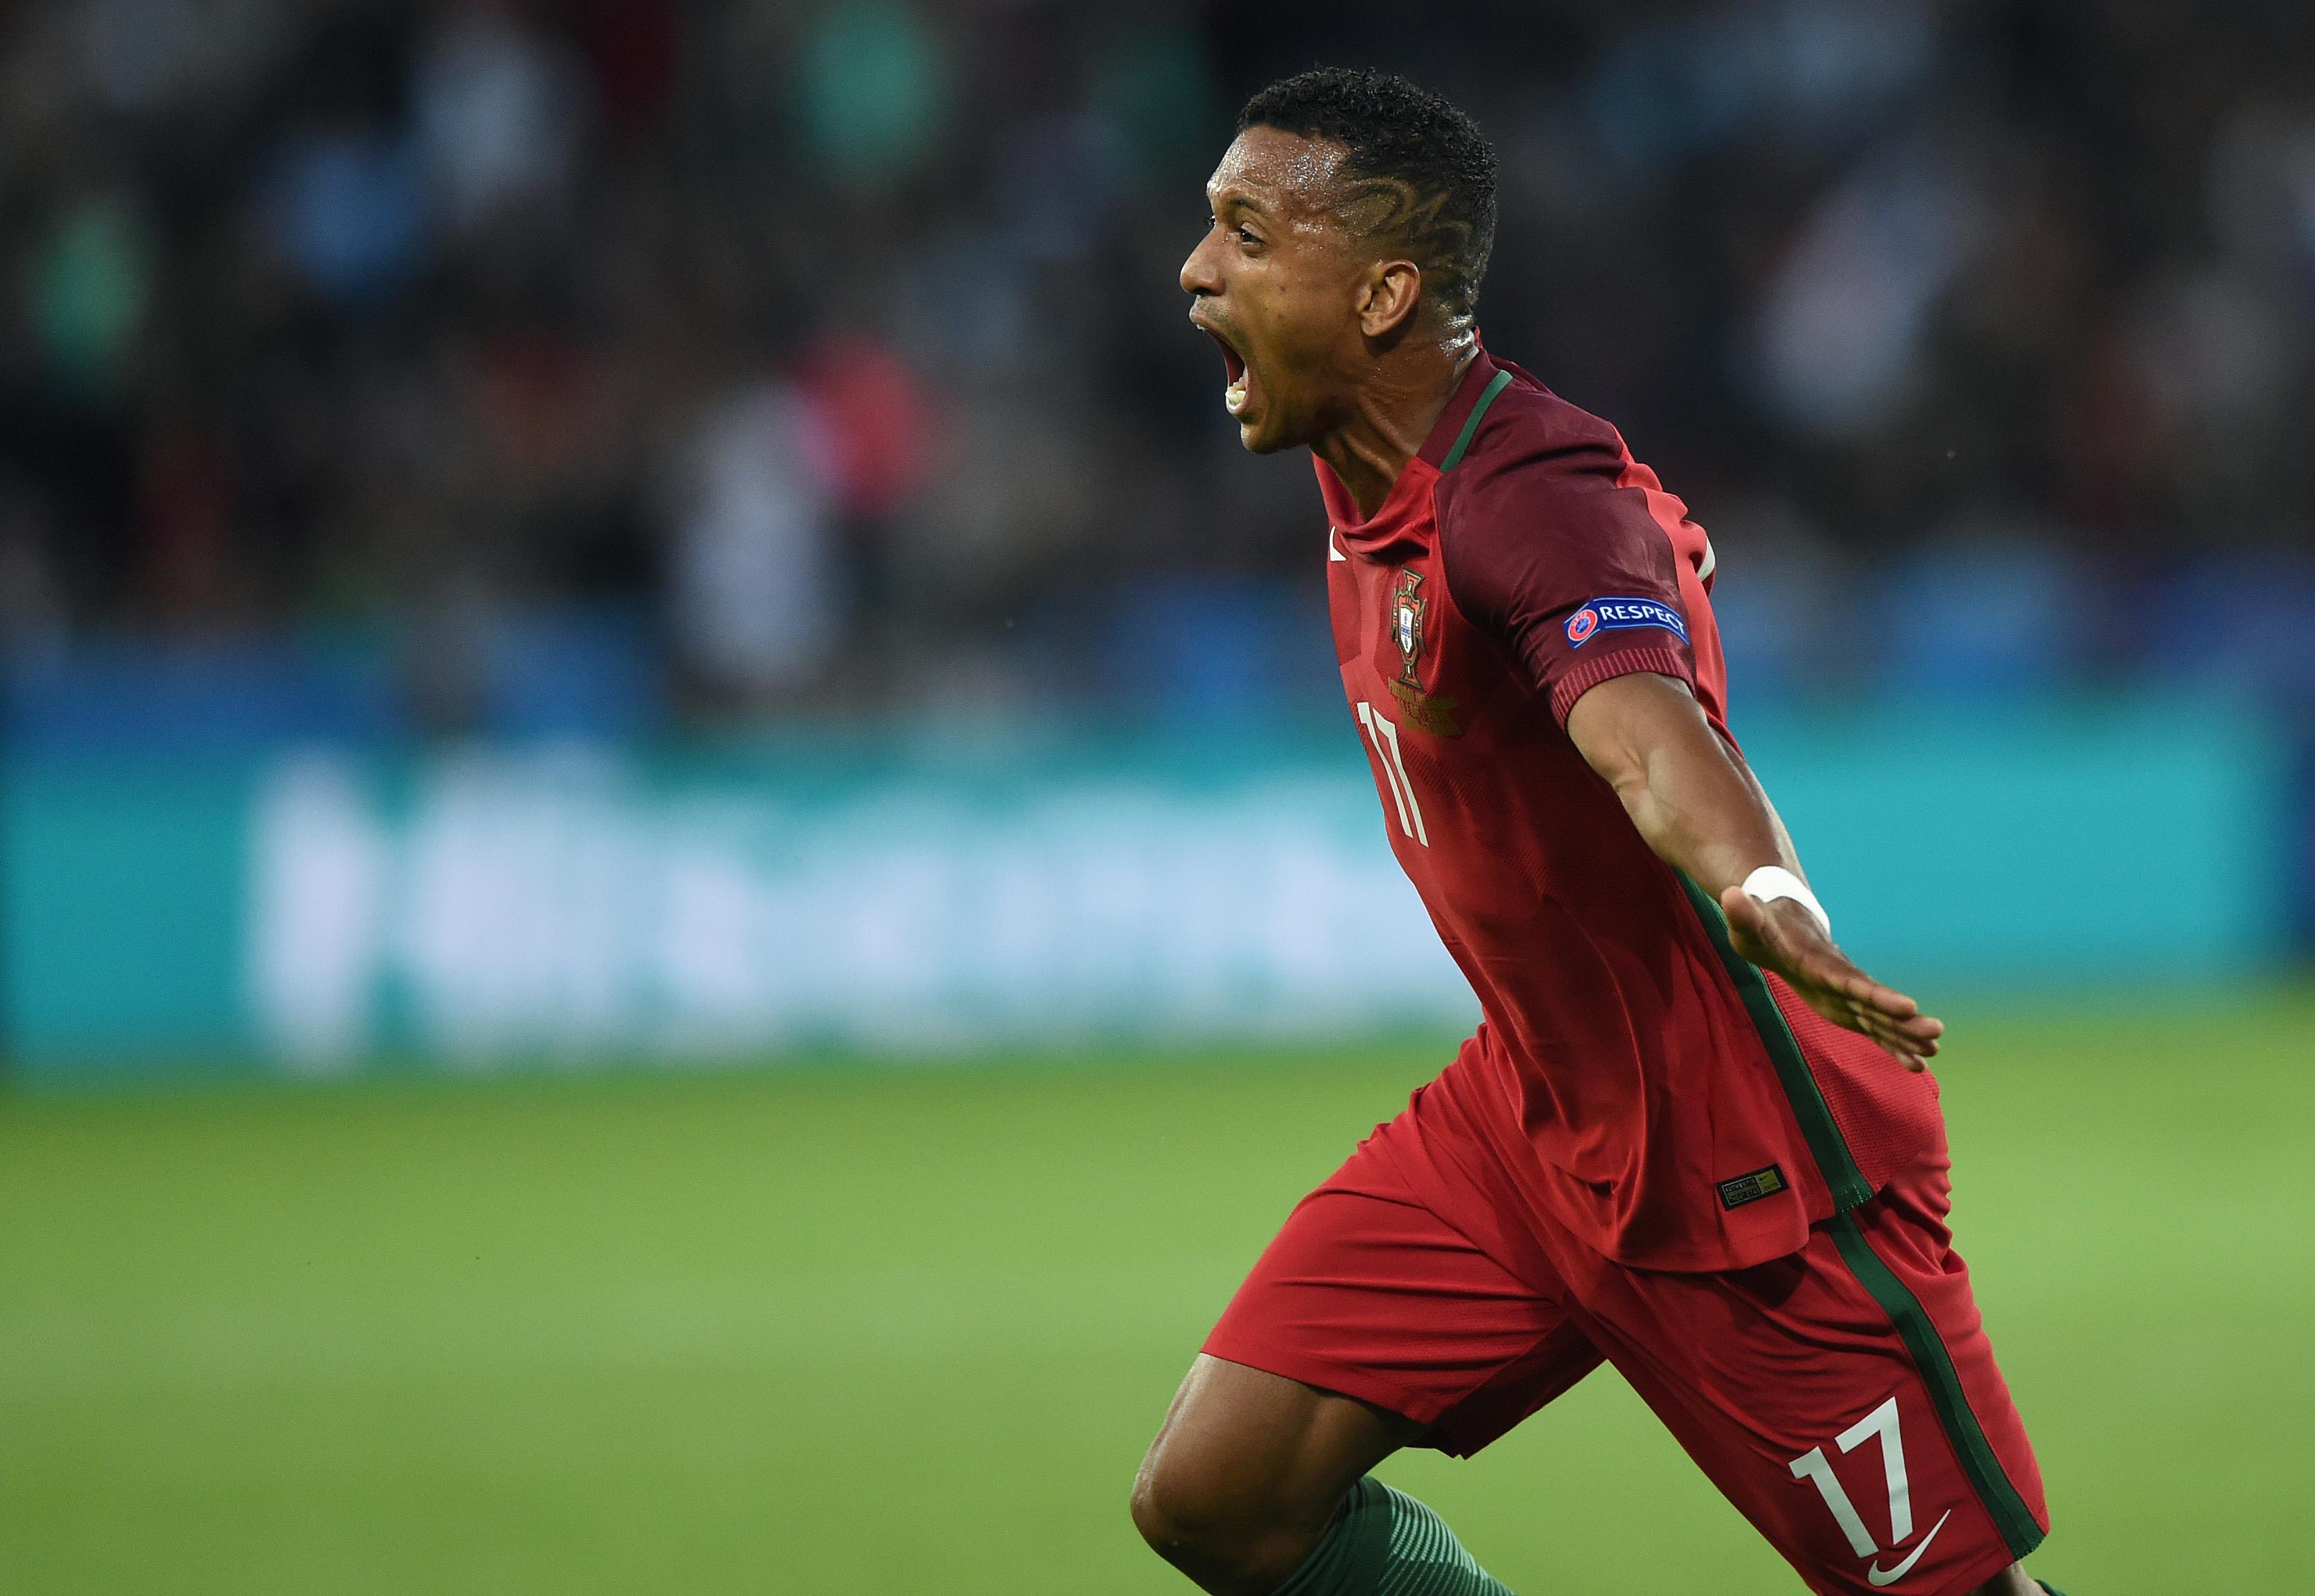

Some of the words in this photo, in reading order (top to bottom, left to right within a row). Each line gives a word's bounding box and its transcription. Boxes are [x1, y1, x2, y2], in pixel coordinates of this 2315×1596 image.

[1599, 605, 1684, 635] RESPECT
[1357, 701, 1429, 848] 17
[1788, 1396, 1913, 1559] 17
